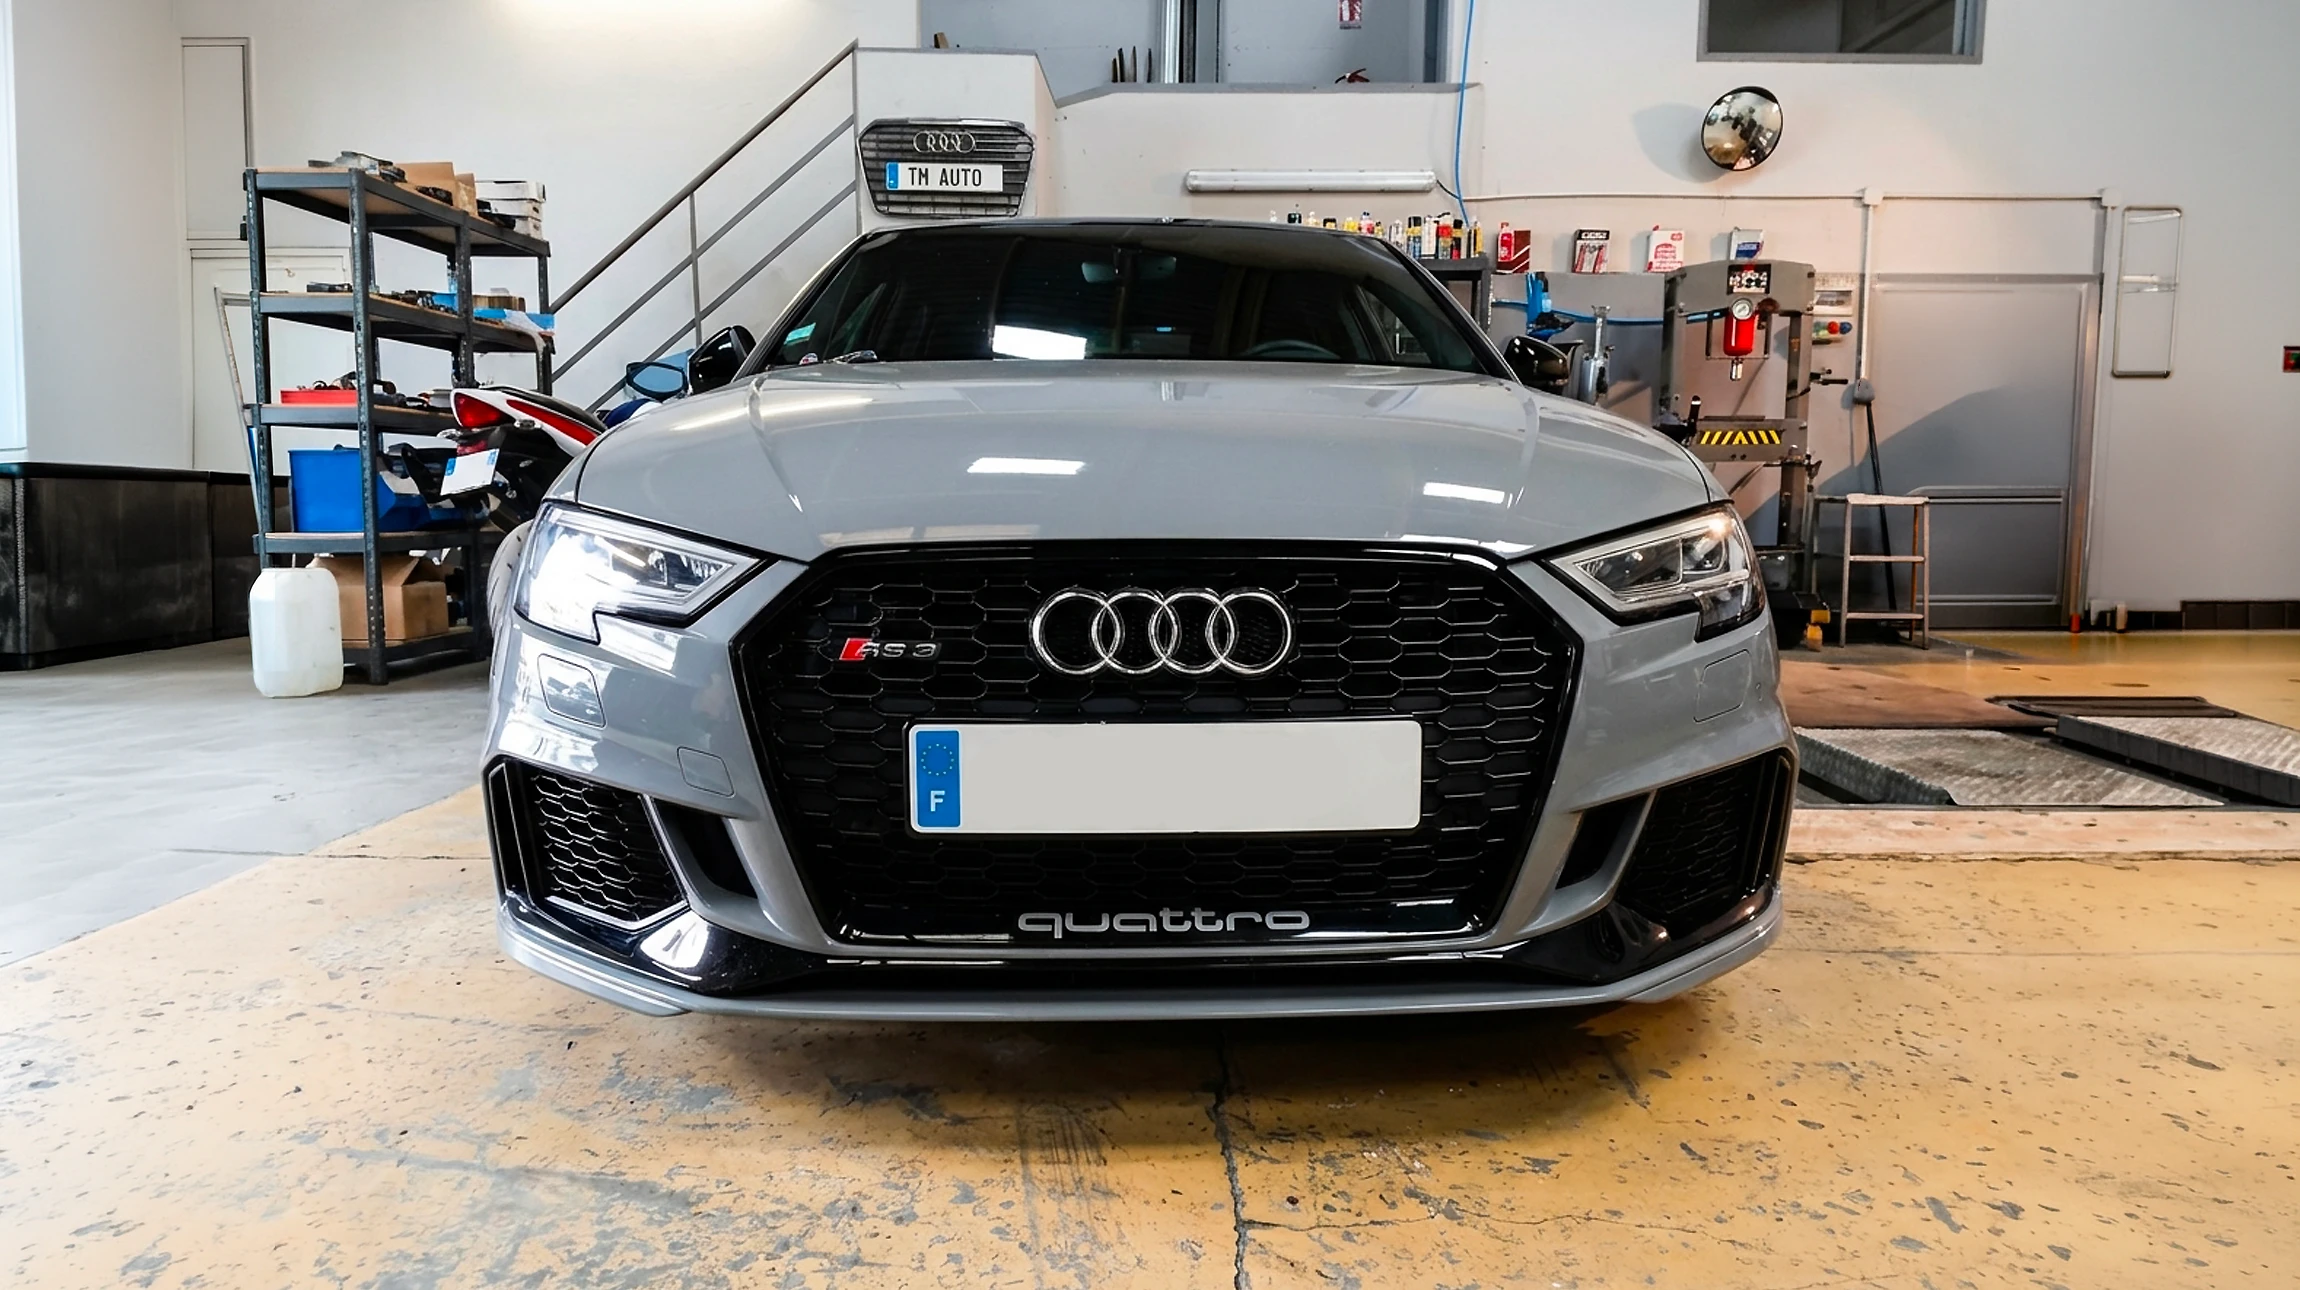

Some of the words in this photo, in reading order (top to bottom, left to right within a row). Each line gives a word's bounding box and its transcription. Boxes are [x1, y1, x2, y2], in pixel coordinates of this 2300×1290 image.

[908, 167, 929, 187] TM
[939, 167, 982, 187] AUTO
[930, 790, 946, 812] F
[1018, 907, 1310, 939] quattro
